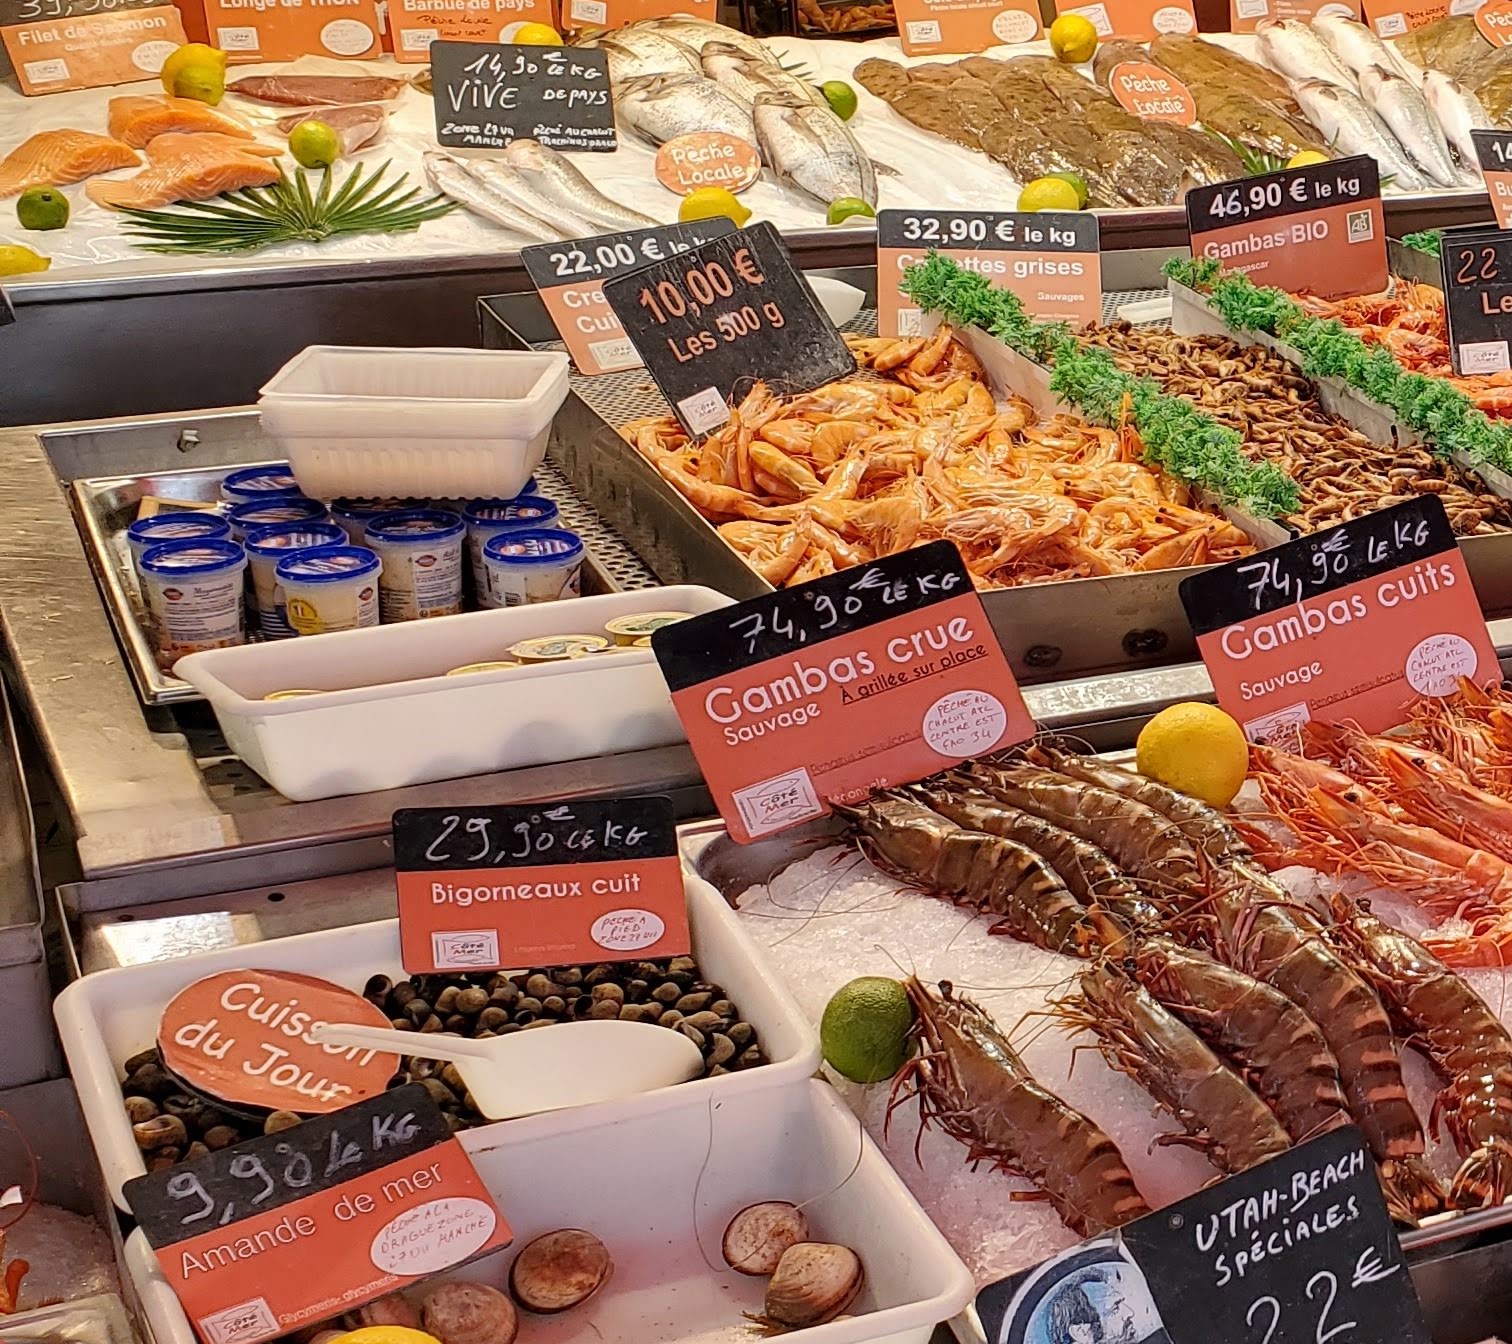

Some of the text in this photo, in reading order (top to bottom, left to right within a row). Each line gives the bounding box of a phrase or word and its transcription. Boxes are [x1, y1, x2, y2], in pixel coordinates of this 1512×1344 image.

[1119, 73, 1172, 94] Pêche
[677, 162, 746, 186] Locale
[903, 217, 1077, 247] 32,90 € le kg
[1203, 219, 1330, 261] Gambas BIO
[1014, 258, 1084, 278] grises
[1037, 291, 1086, 301] Sauvages
[667, 300, 786, 364] Les 500 g
[1220, 560, 1457, 660] Gambas cuits
[703, 614, 975, 725] Gambas crue
[1240, 661, 1324, 701] Sauvage
[431, 872, 641, 906] Bigorneaux cuit
[174, 1018, 354, 1103] du Jour
[179, 1161, 445, 1280] Amande de mer
[1195, 1149, 1366, 1253] UTAH-BEACH
[1214, 1194, 1361, 1288] SPÉCIALES
